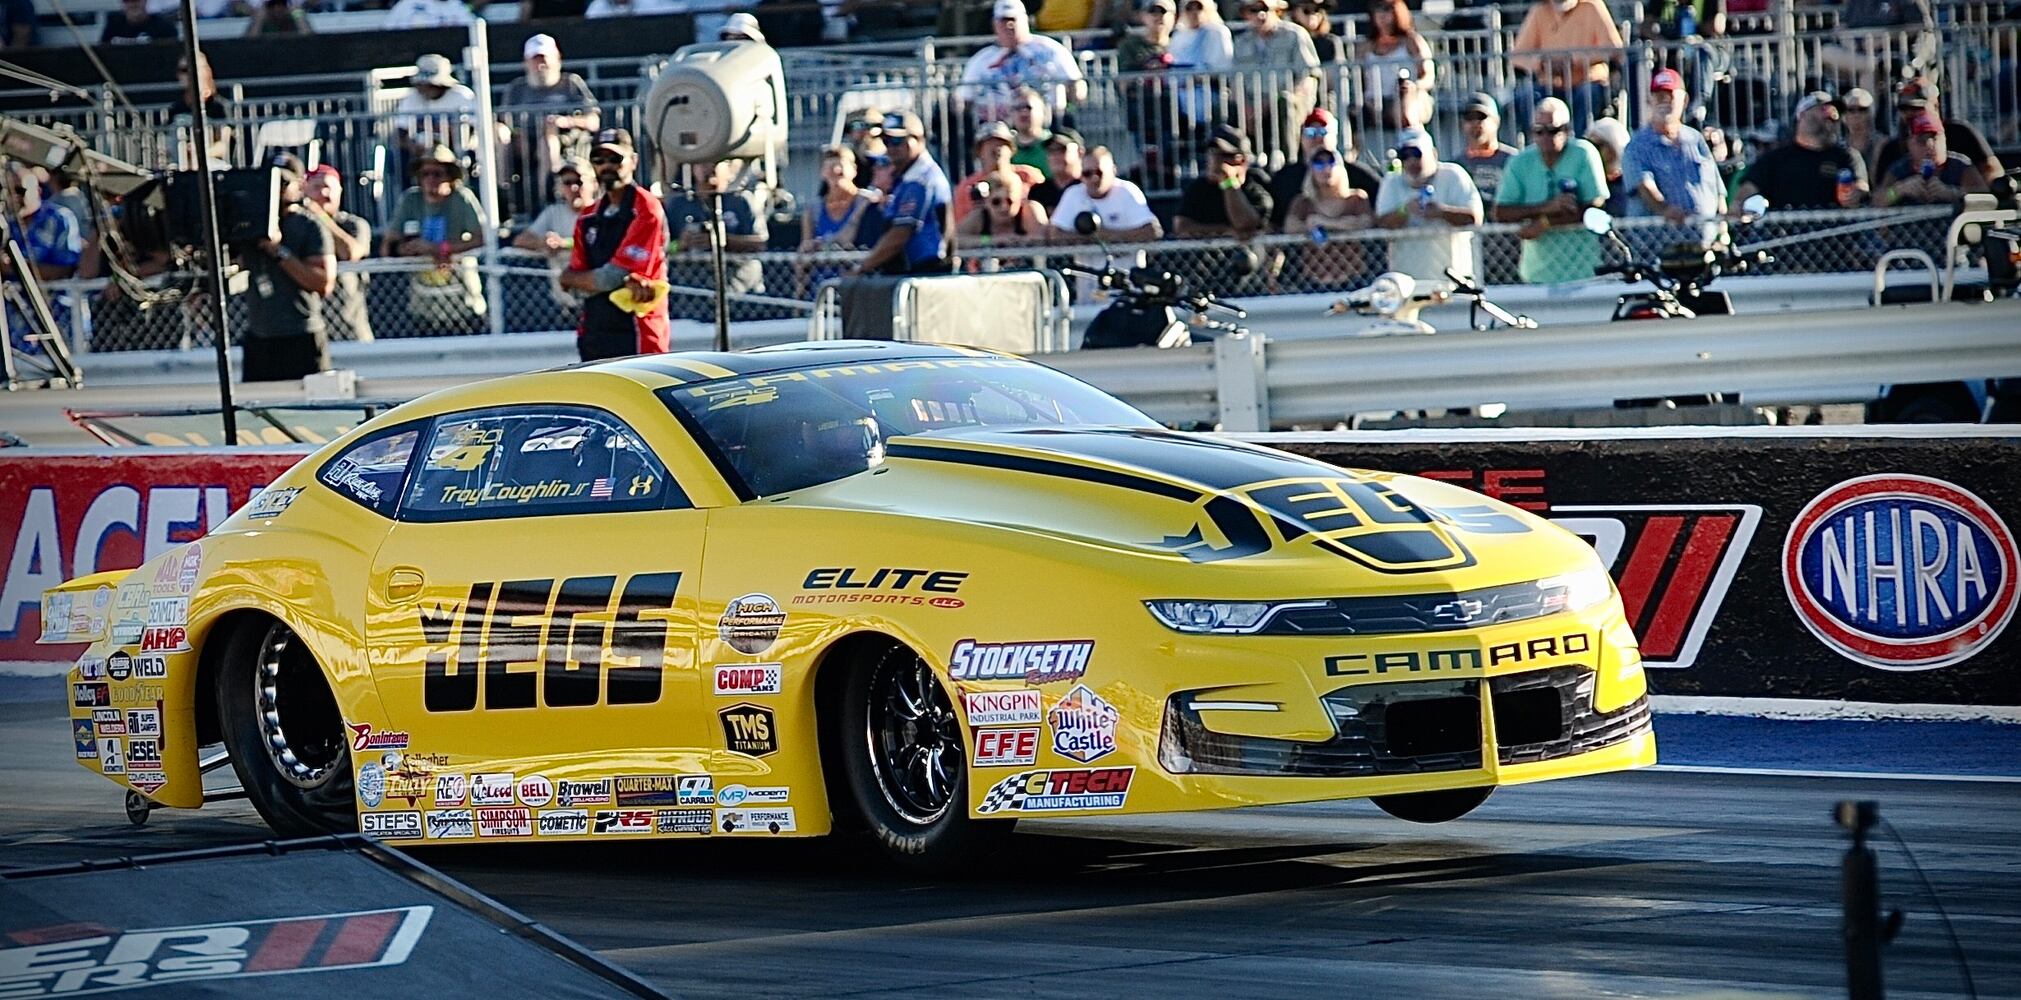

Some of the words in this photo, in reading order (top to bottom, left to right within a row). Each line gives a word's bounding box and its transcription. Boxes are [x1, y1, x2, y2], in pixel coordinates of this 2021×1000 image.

[438, 444, 493, 471] 4
[440, 485, 485, 506] Troy
[482, 480, 569, 503] Coughlin
[1821, 506, 1988, 627] NHRA
[153, 583, 175, 593] TOOLS
[802, 567, 970, 593] ELITE
[736, 602, 774, 613] HIGH
[932, 598, 960, 608] LLC
[142, 627, 185, 651] ARP
[424, 571, 683, 712] JEGS
[950, 642, 1093, 678] STOCKSETH
[1324, 633, 1590, 676] CAMARO
[134, 657, 165, 677] WELD
[717, 669, 765, 690] COMP
[75, 685, 97, 706] Holley
[113, 682, 164, 704] GOODYEAR
[969, 693, 1039, 714] KINGPIN
[95, 711, 120, 721] LINCOLN
[970, 713, 1017, 723] INDUSTRIAL
[1019, 712, 1040, 721] PARK
[1057, 711, 1110, 733] White
[726, 713, 770, 740] TMS
[127, 741, 161, 761] JESEL
[734, 740, 771, 751] TITANIUM
[977, 731, 1036, 759] CFE
[1055, 731, 1113, 751] Castle
[522, 783, 549, 798] BELL
[558, 780, 611, 797] Browell
[617, 777, 673, 793] QUARTER-MAX
[680, 796, 715, 805] CARRILLO
[1026, 795, 1121, 809] MANUFACTURING
[364, 814, 418, 831] STEF'S
[480, 810, 527, 829] SIMPSON
[539, 814, 587, 831] COMETIC
